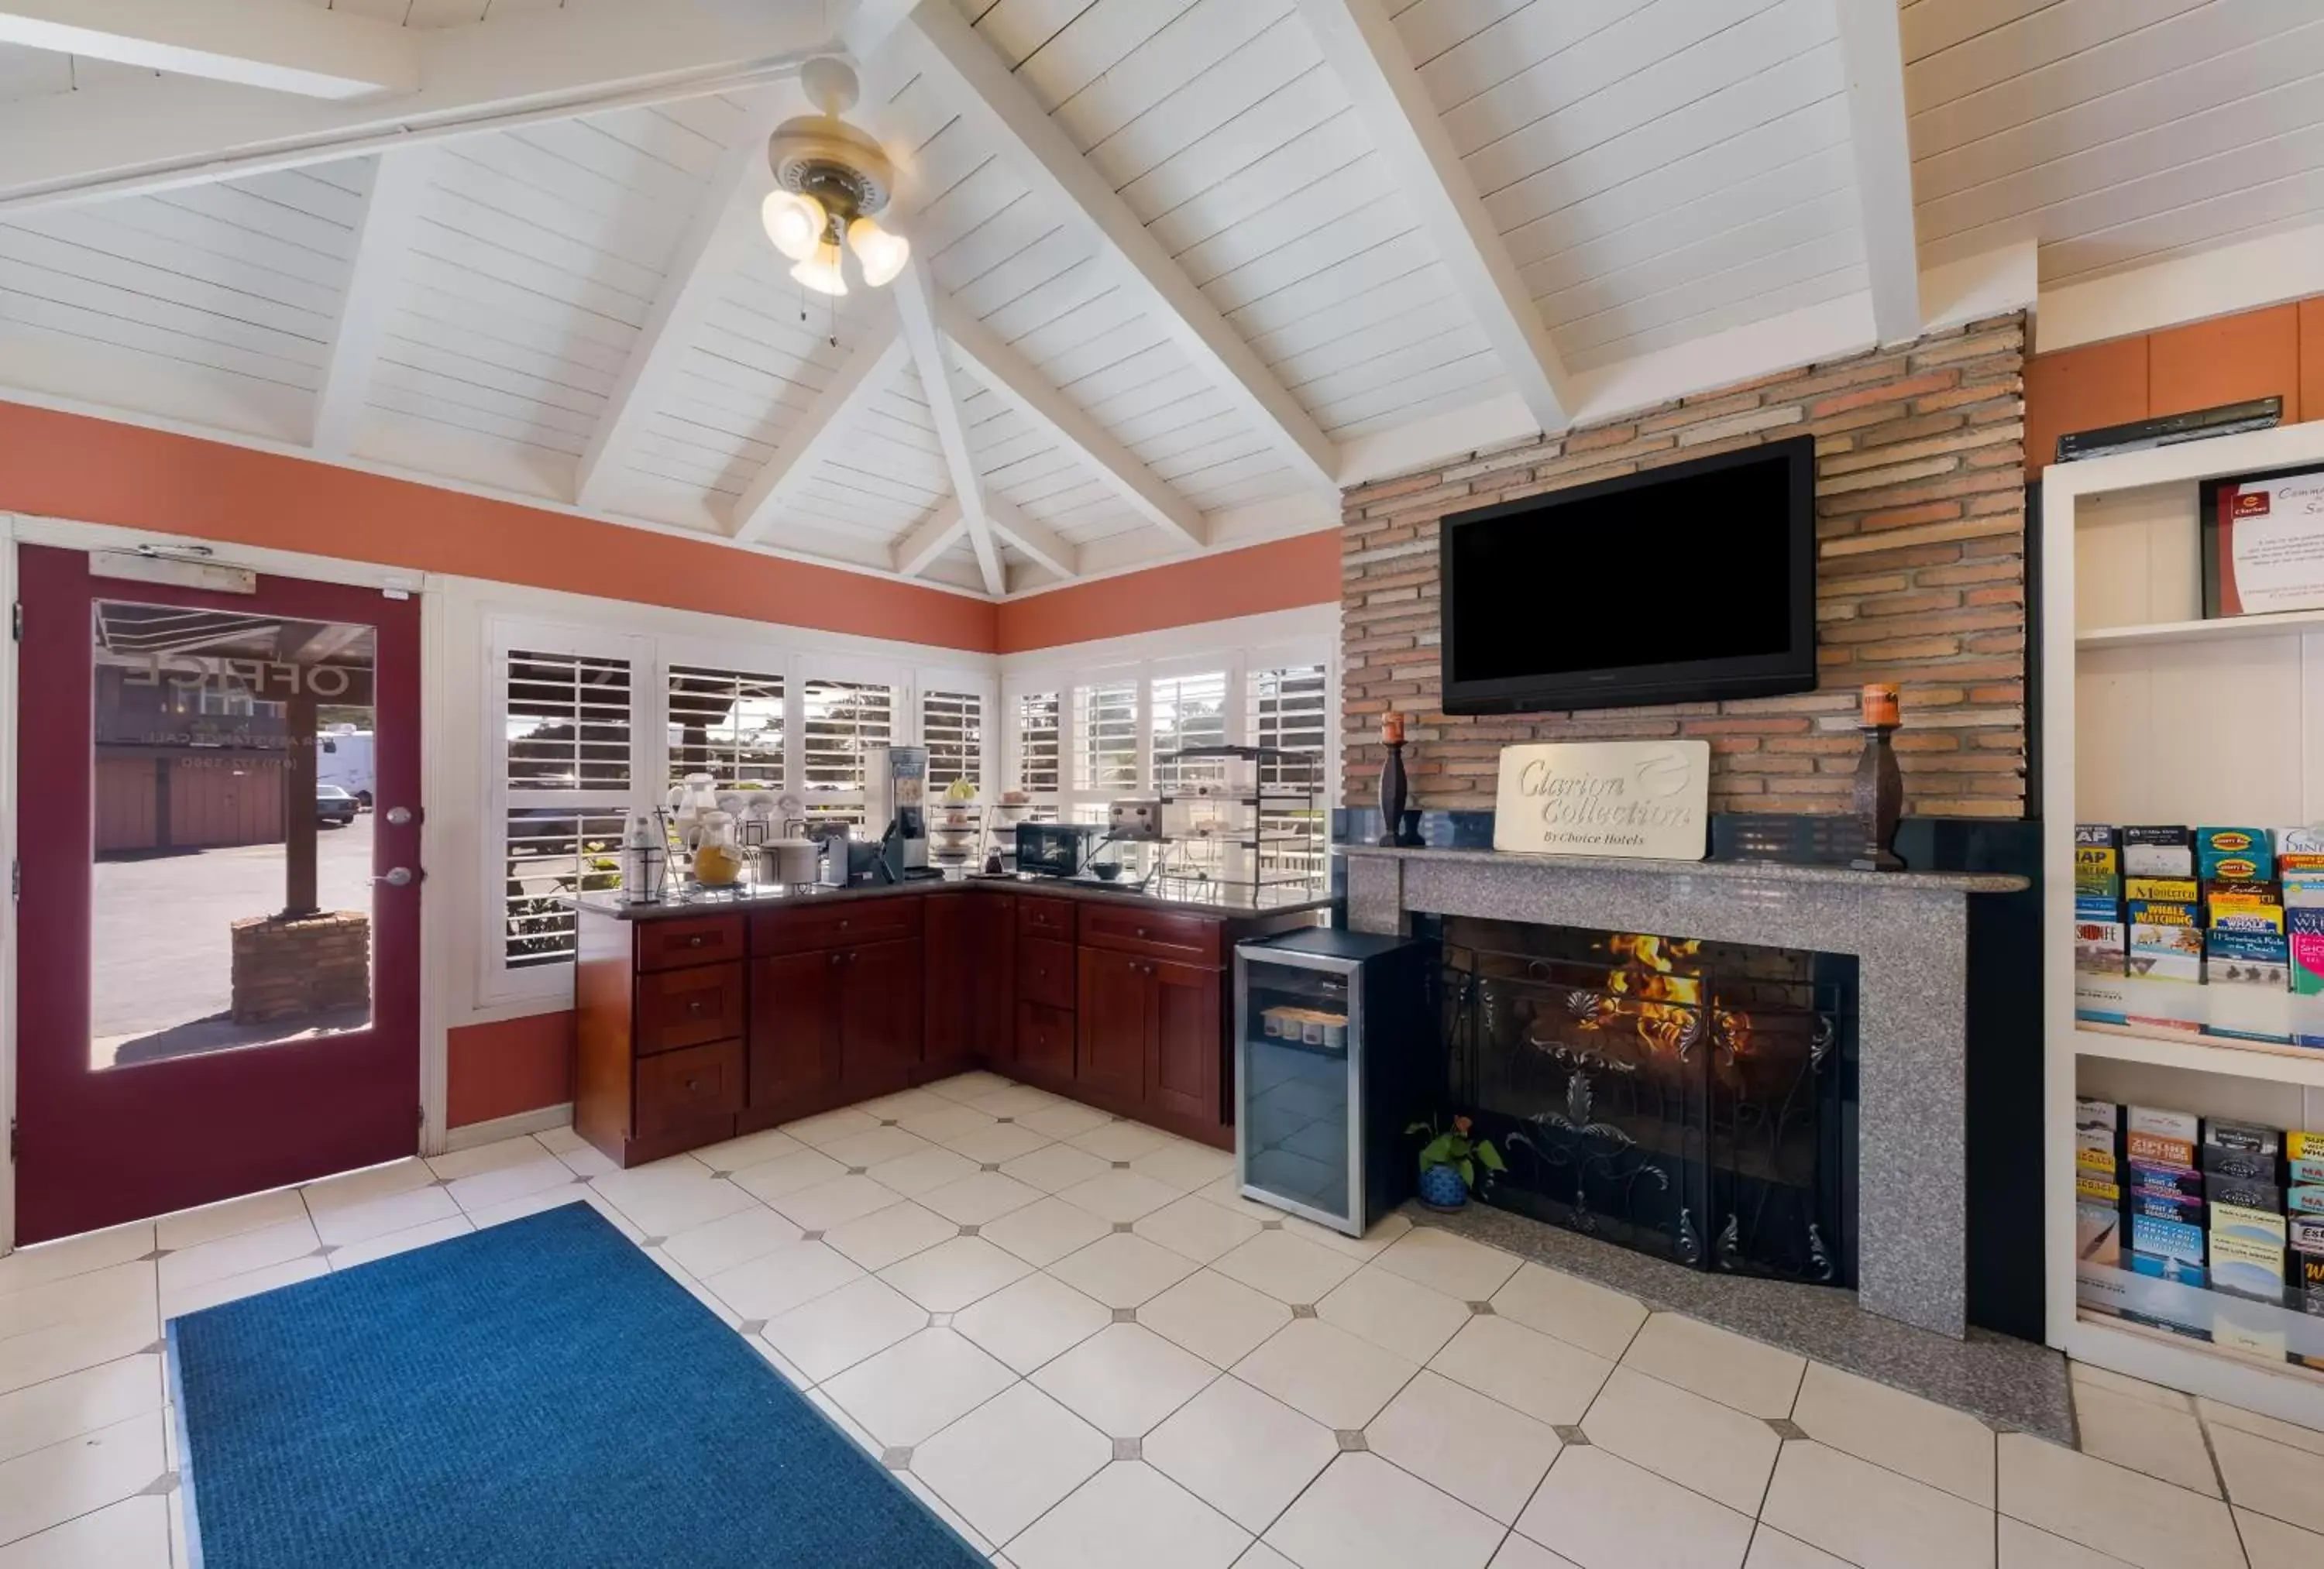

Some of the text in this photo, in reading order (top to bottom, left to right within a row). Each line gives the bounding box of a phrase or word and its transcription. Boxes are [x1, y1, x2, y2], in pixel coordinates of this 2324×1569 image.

[1519, 759, 1625, 797] Clarion
[1542, 794, 1691, 826] Collection
[1544, 830, 1645, 846] By Choice Hotels
[2147, 903, 2186, 915] WHALE
[2134, 912, 2194, 926] WATCHING
